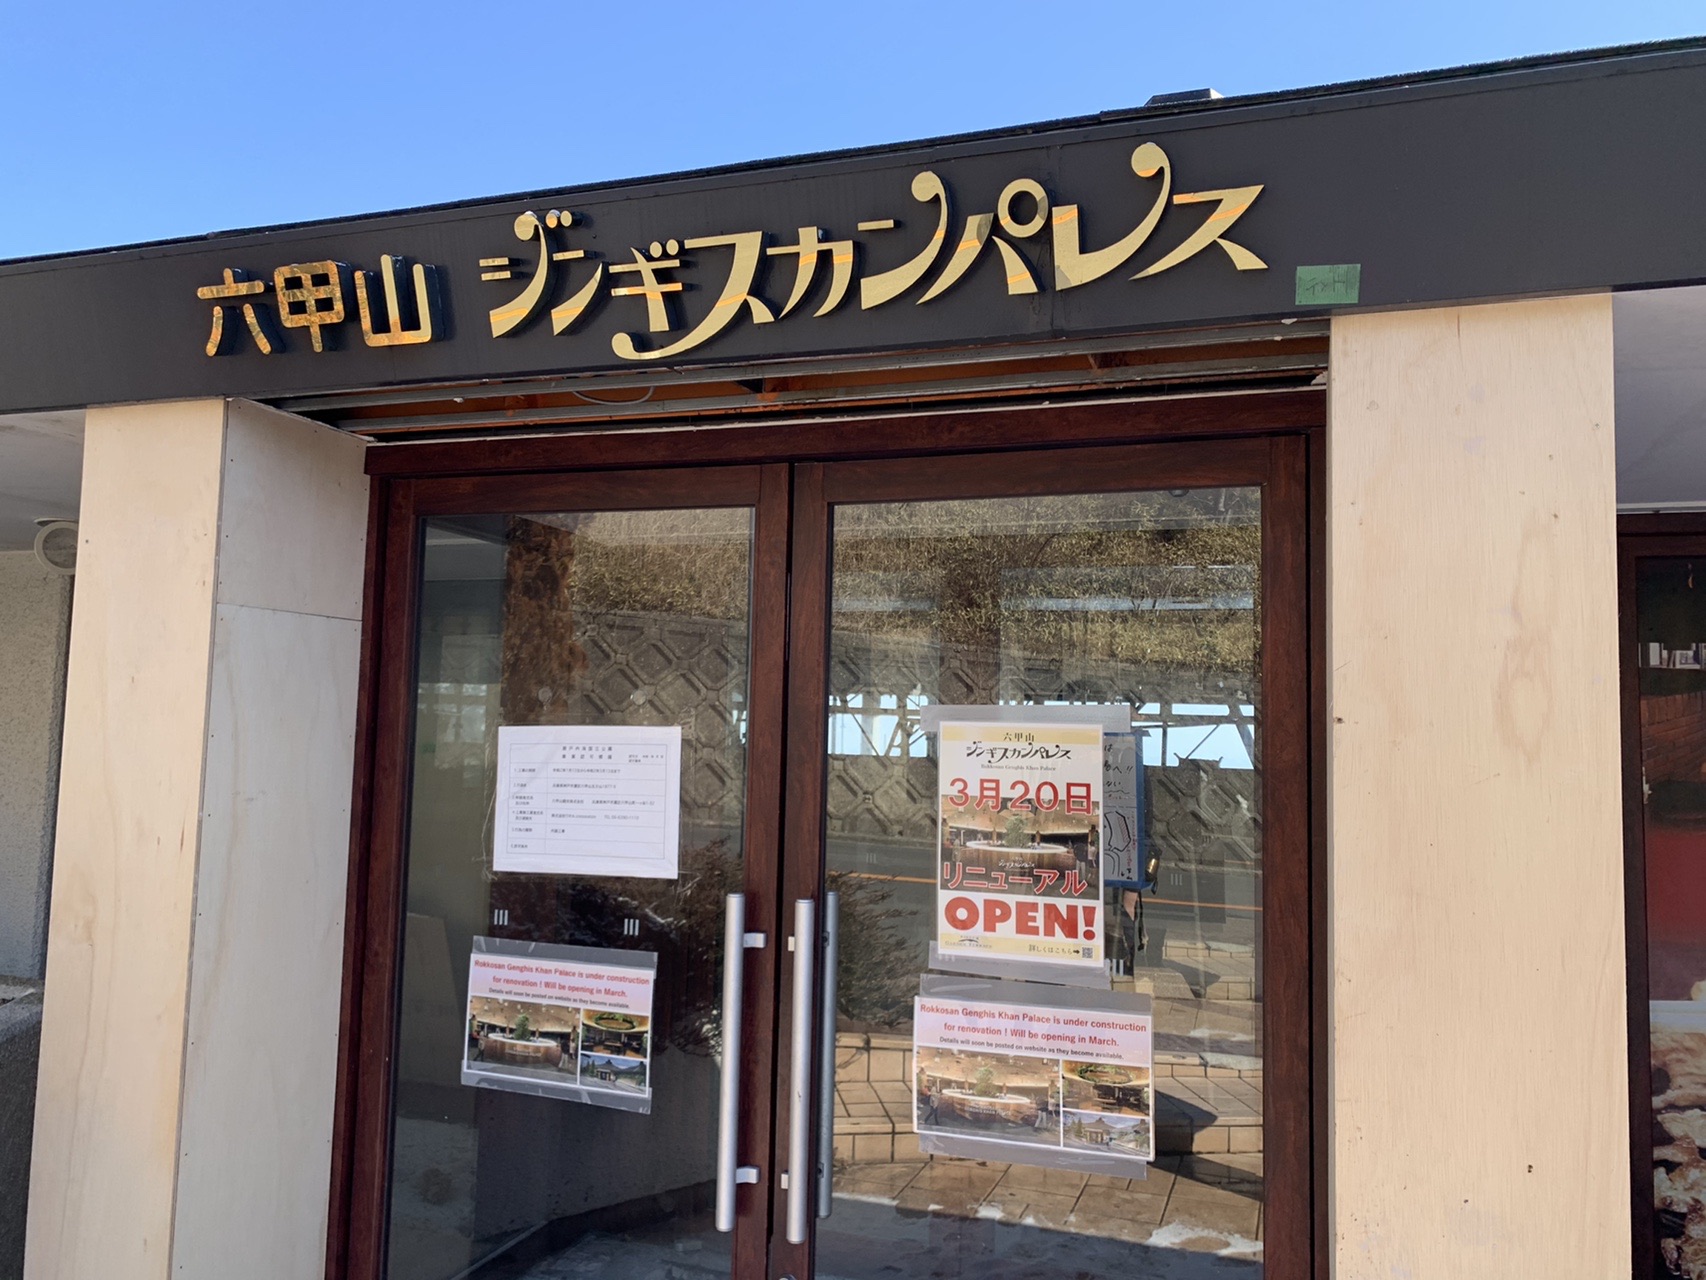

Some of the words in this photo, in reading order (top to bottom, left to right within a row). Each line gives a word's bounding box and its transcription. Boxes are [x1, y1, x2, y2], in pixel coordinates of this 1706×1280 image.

[197, 255, 433, 357] 六甲山
[479, 142, 1269, 361] ジンギスカンパレス
[1003, 732, 1035, 742] 六甲山
[966, 741, 1072, 764] ジンギスカンパレス
[948, 777, 1092, 816] 3月20日
[943, 861, 1088, 897] リニューアル
[944, 896, 1097, 941] OPEN!
[1028, 944, 1073, 955] 詳しくはこちら
[474, 959, 505, 969] Rokkosan
[507, 963, 533, 973] Genghis
[535, 966, 553, 975] Khan
[554, 968, 576, 977] Palace
[585, 972, 605, 980] under
[606, 974, 650, 985] construction
[492, 975, 502, 983] for
[503, 977, 538, 988] renovation
[544, 981, 557, 989] Will
[568, 985, 594, 996] opening
[604, 988, 628, 998] March.
[920, 1004, 959, 1015] Rokkosan
[961, 1008, 995, 1019] Genghis
[998, 1011, 1020, 1021] Khan
[1022, 1013, 1051, 1024] Palace
[1053, 1015, 1061, 1025] is
[1063, 1018, 1088, 1027] under
[1090, 1020, 1147, 1032] construction
[944, 1022, 955, 1031] for
[957, 1025, 1002, 1036] renovation
[1010, 1029, 1026, 1038] Will
[1028, 1030, 1038, 1039] be
[1041, 1033, 1076, 1044] opening
[1078, 1035, 1086, 1043] in
[1089, 1036, 1120, 1047] March.
